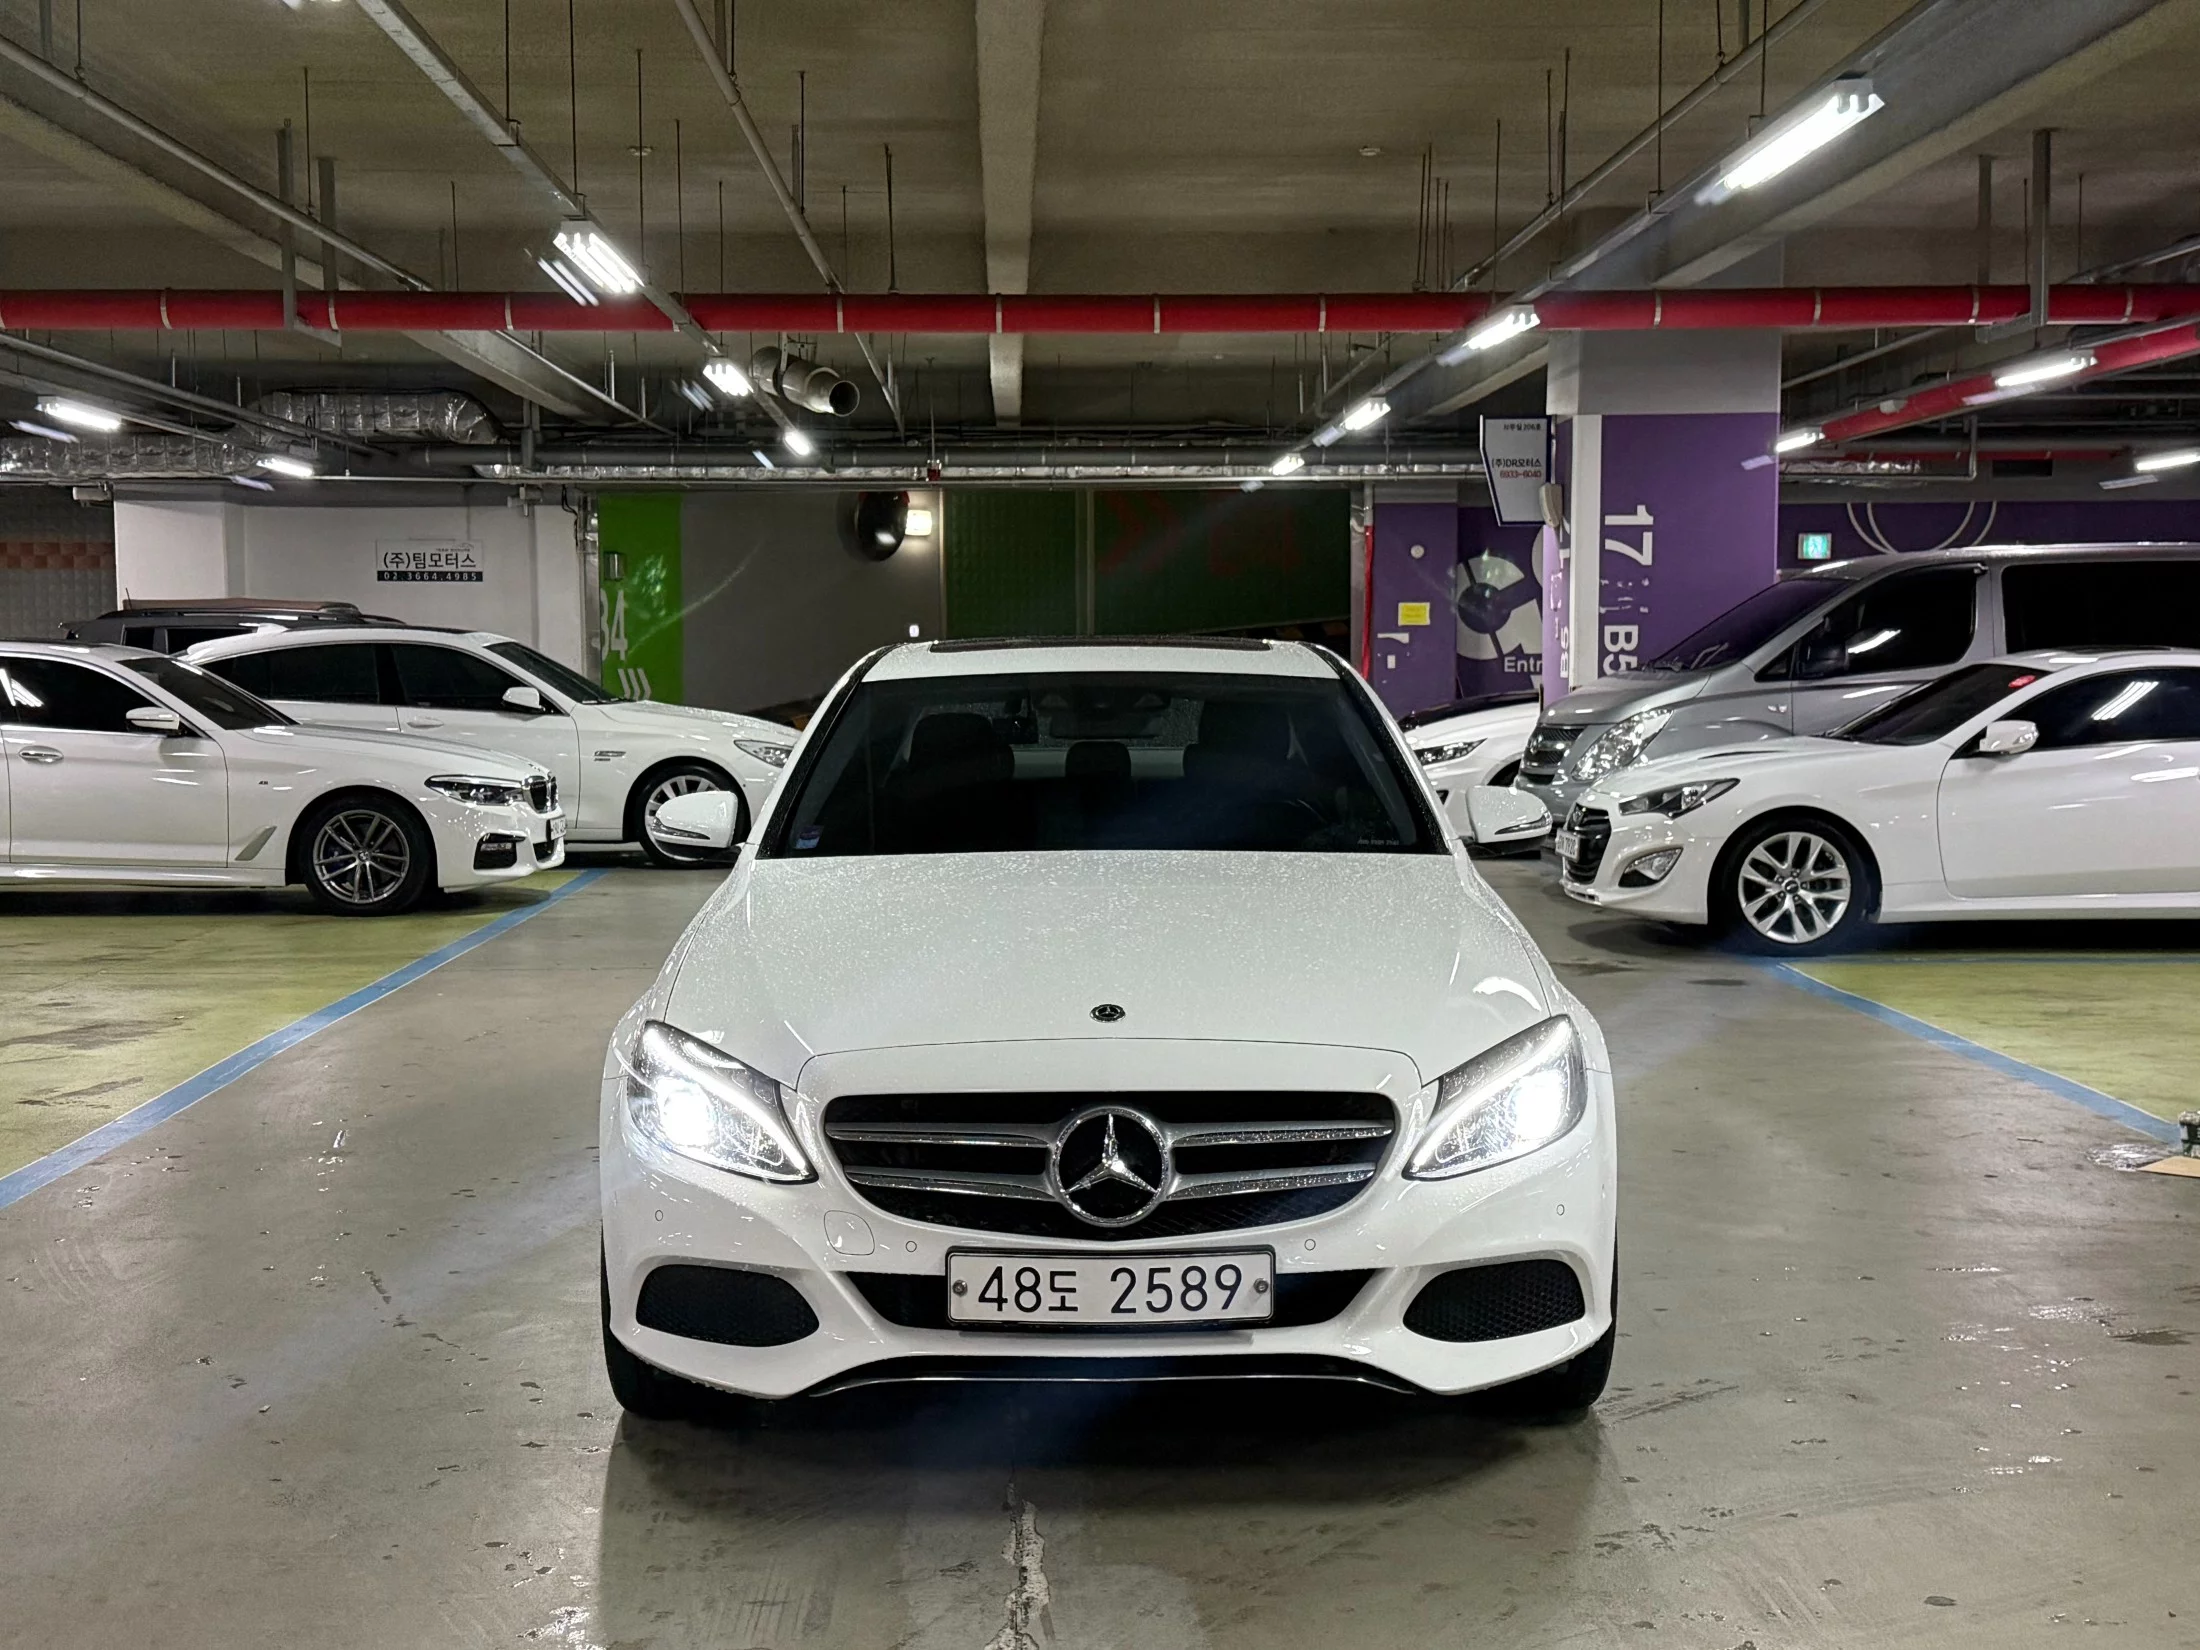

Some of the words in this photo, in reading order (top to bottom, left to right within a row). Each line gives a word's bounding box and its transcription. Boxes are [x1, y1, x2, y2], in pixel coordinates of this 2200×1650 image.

[1604, 504, 1654, 566] 17
[383, 552, 477, 570] (주)팀모터스
[1602, 624, 1639, 676] B5
[977, 1265, 1079, 1313] 48도
[1109, 1263, 1243, 1314] 2589
